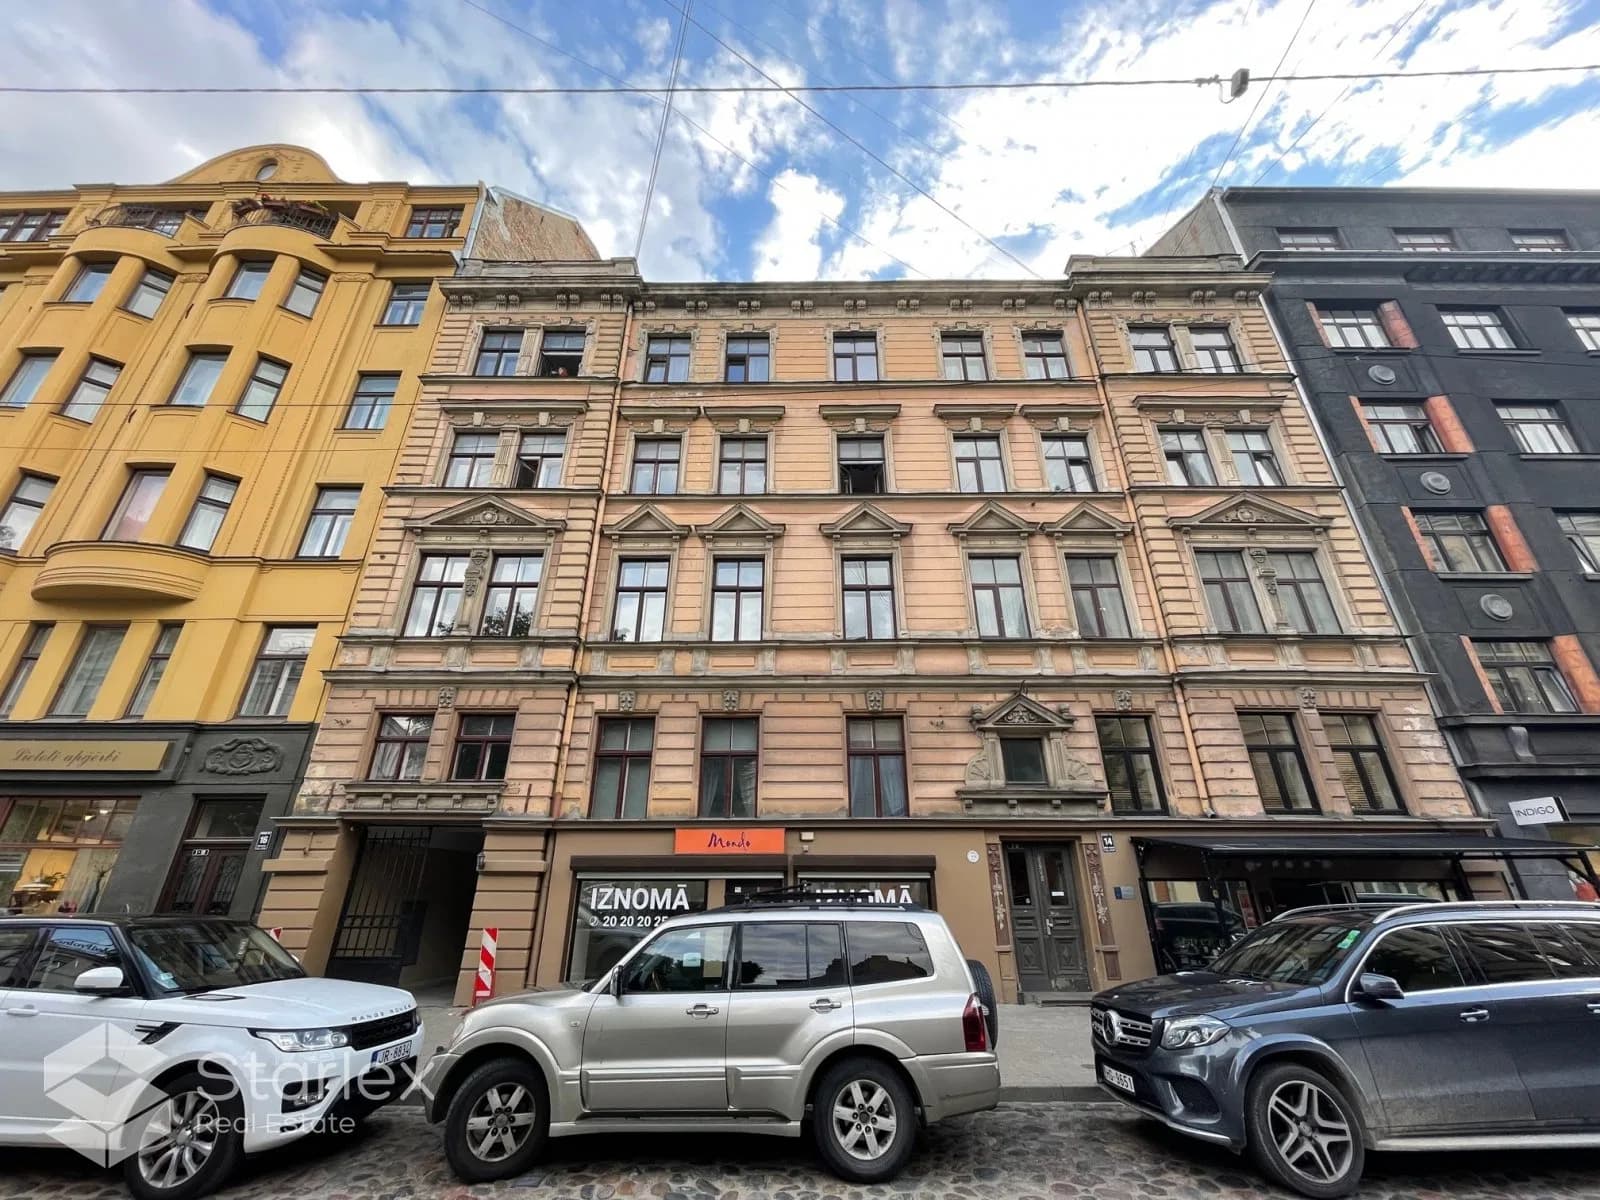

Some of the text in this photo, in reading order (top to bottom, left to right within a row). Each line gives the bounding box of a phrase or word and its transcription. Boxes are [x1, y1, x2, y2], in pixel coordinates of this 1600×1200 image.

[1515, 805, 1555, 816] INDIGO
[707, 831, 751, 848] Mondo
[1103, 837, 1113, 846] 14
[590, 884, 690, 910] IZNOMĀ
[602, 915, 617, 927] 20
[619, 915, 634, 927] 20
[637, 915, 651, 927] 20
